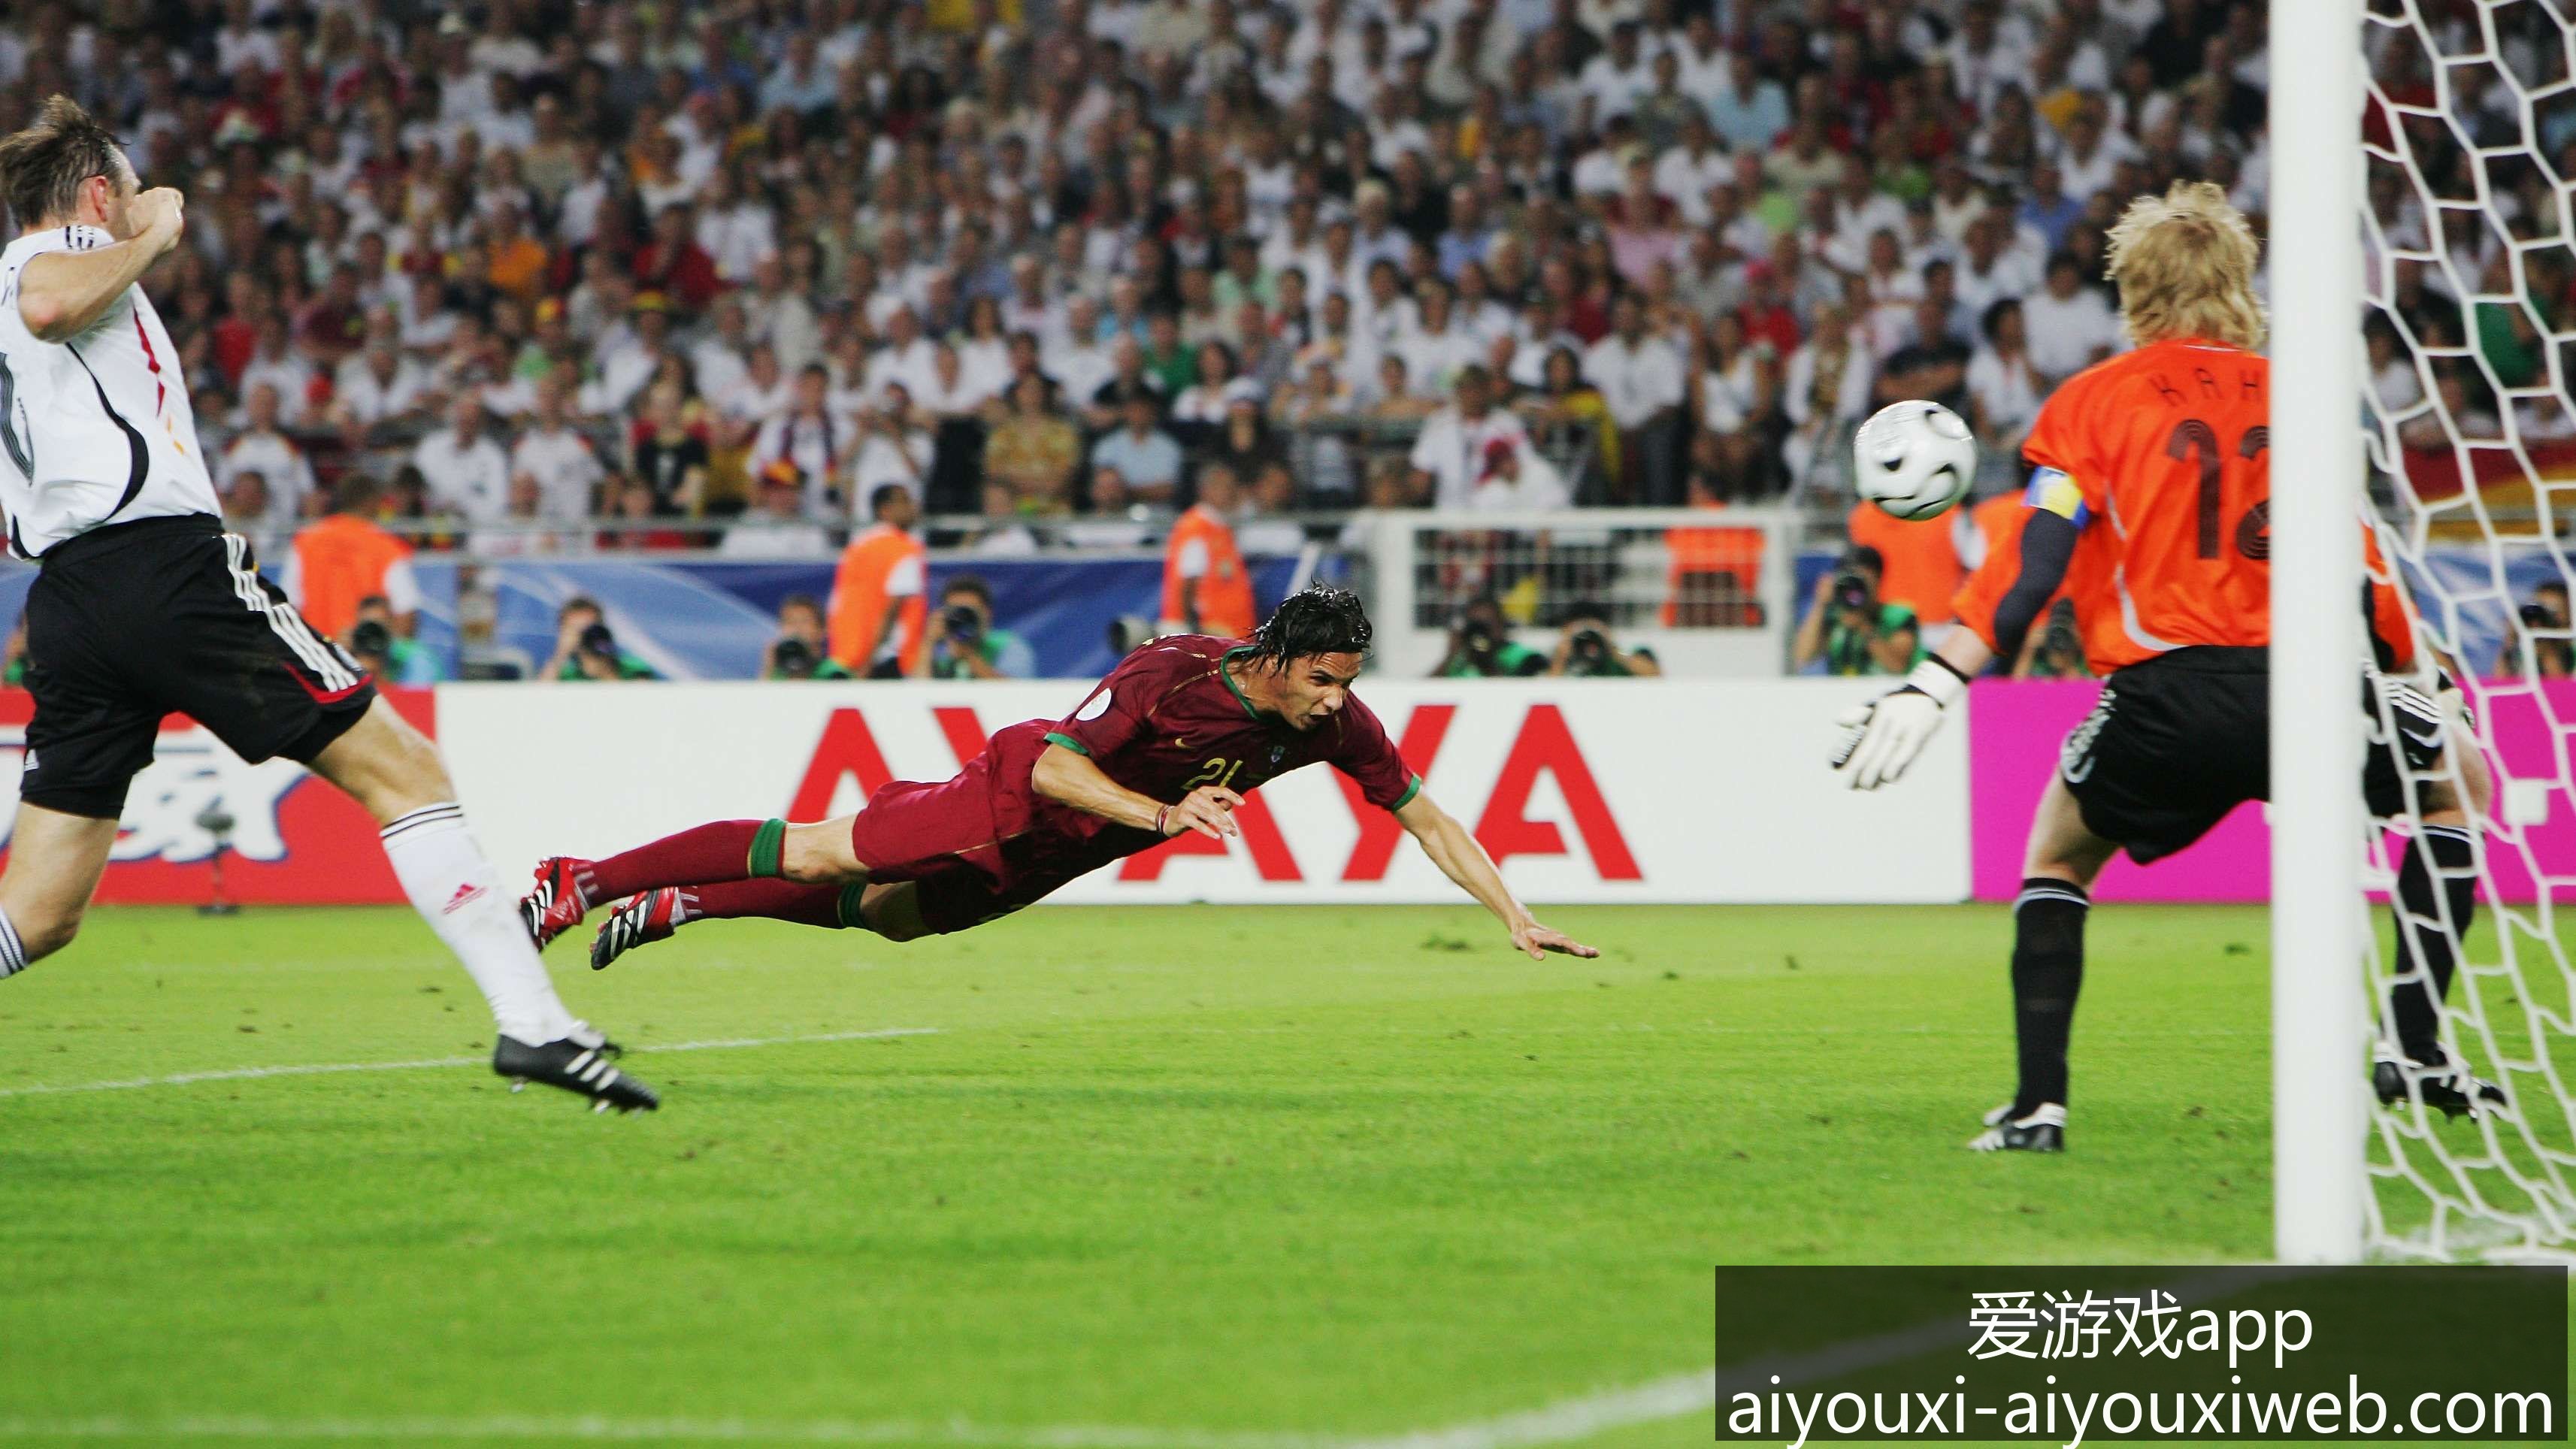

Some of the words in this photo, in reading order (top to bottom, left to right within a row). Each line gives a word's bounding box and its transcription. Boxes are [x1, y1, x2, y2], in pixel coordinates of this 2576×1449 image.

[2148, 367, 2263, 407] KAH
[784, 704, 1644, 882] AAYA
[1180, 757, 1244, 791] 21
